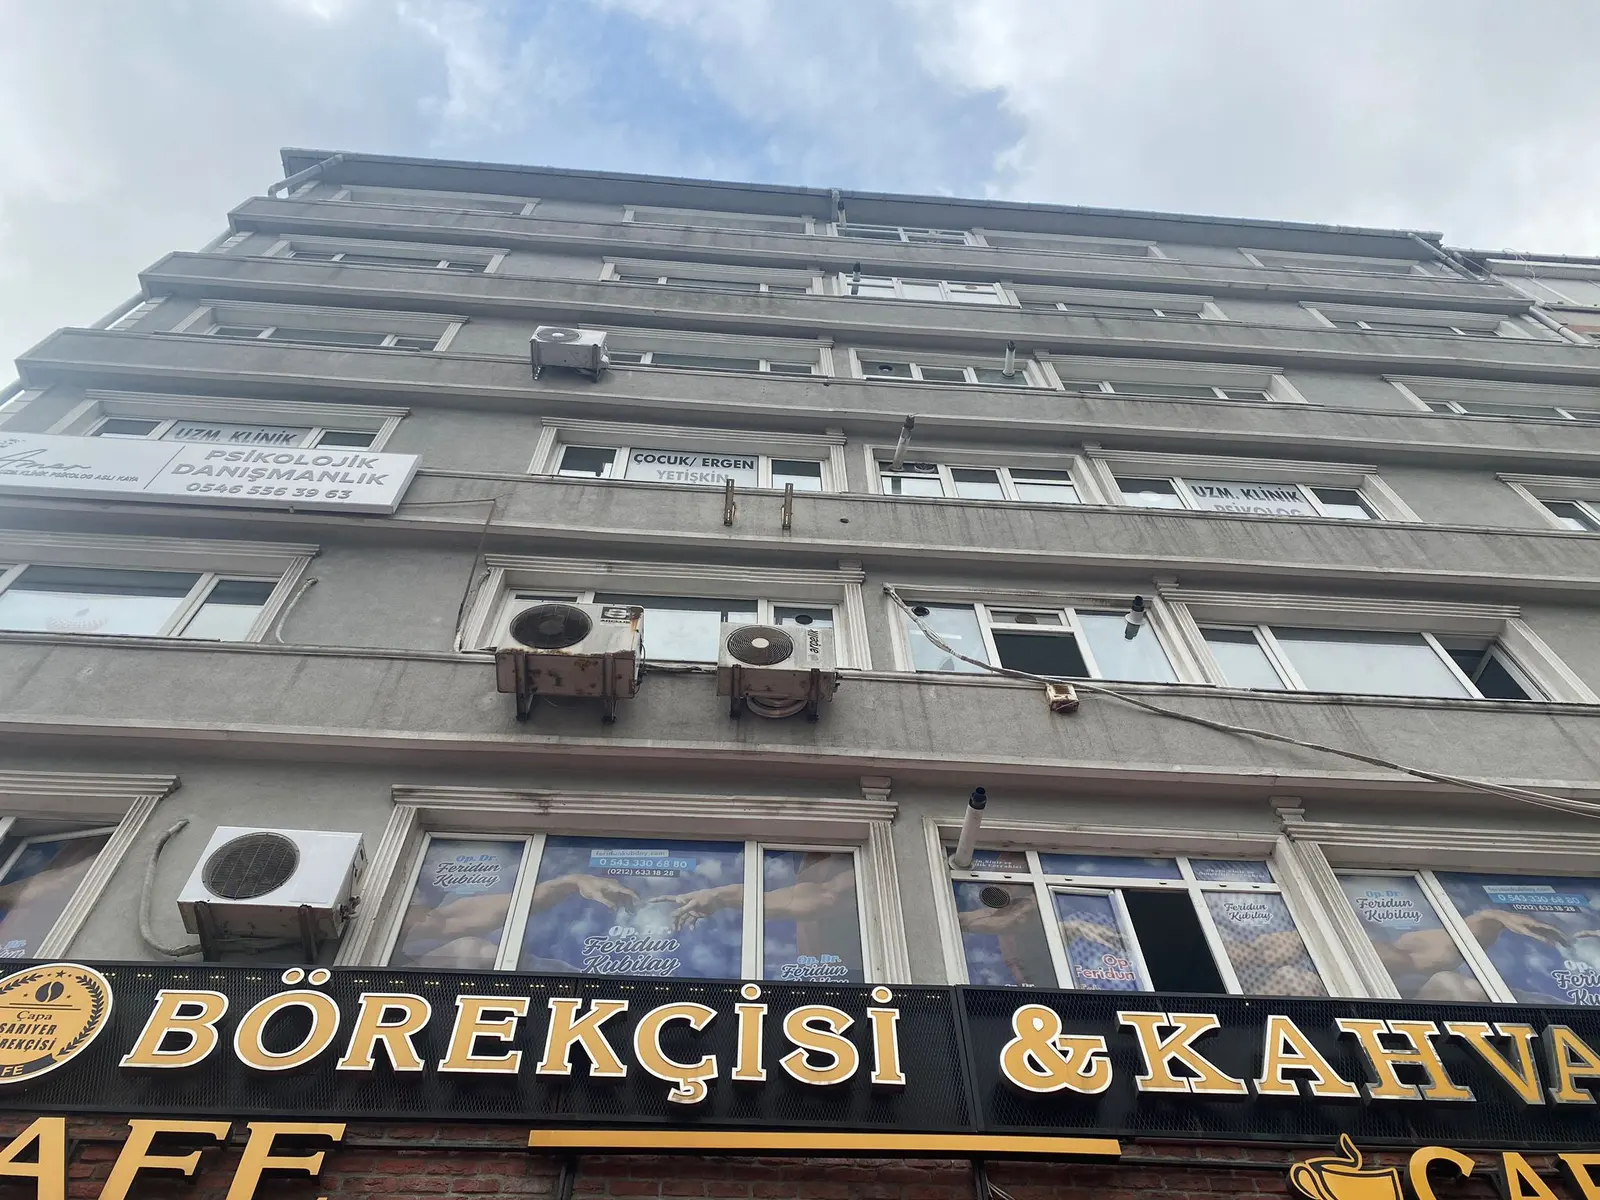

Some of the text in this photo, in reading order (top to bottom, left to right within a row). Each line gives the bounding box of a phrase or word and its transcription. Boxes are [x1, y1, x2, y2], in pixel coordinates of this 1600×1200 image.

[204, 449, 380, 469] PSİKOLOJİK
[701, 457, 754, 470] ERGEN
[170, 463, 390, 486] DANIŞMANLIK
[656, 469, 729, 484] YETİŞKİN
[185, 481, 354, 500] 0546 556 39 63
[1191, 485, 1304, 503] UZM. KLİNİK
[456, 855, 476, 863] Op.
[609, 858, 630, 866] 543
[632, 859, 653, 867] 330
[656, 860, 670, 868] 68
[673, 860, 687, 868] 80
[436, 862, 502, 874] Feridun
[607, 868, 633, 876] (0212)
[663, 869, 674, 877] 28
[433, 874, 501, 887] Kubilay
[1365, 890, 1384, 898] Op.
[1497, 894, 1506, 902] 0
[1507, 894, 1527, 902] 543
[1528, 895, 1548, 903] 330
[1566, 896, 1580, 905] 80
[1223, 902, 1268, 912] Feridun
[1355, 898, 1414, 910] Feridun
[1513, 903, 1538, 912] (0212)
[1228, 911, 1273, 922] Kubilay
[1364, 909, 1423, 923] Kubilay
[609, 925, 638, 939] Op.
[582, 935, 680, 955] Feridun
[580, 954, 680, 977] Kubilay
[797, 954, 842, 965] Op. Dr.
[1102, 953, 1133, 970] Op.
[781, 963, 848, 979] Feridun
[1074, 964, 1136, 981] Feridun
[1563, 960, 1595, 973] Op.
[1550, 969, 1600, 989] Feri
[16, 1010, 53, 1022] Çapa
[118, 967, 1600, 1105] BÖREKÇİSİ & KAHVA
[0, 1036, 57, 1052] REKÇİSİ
